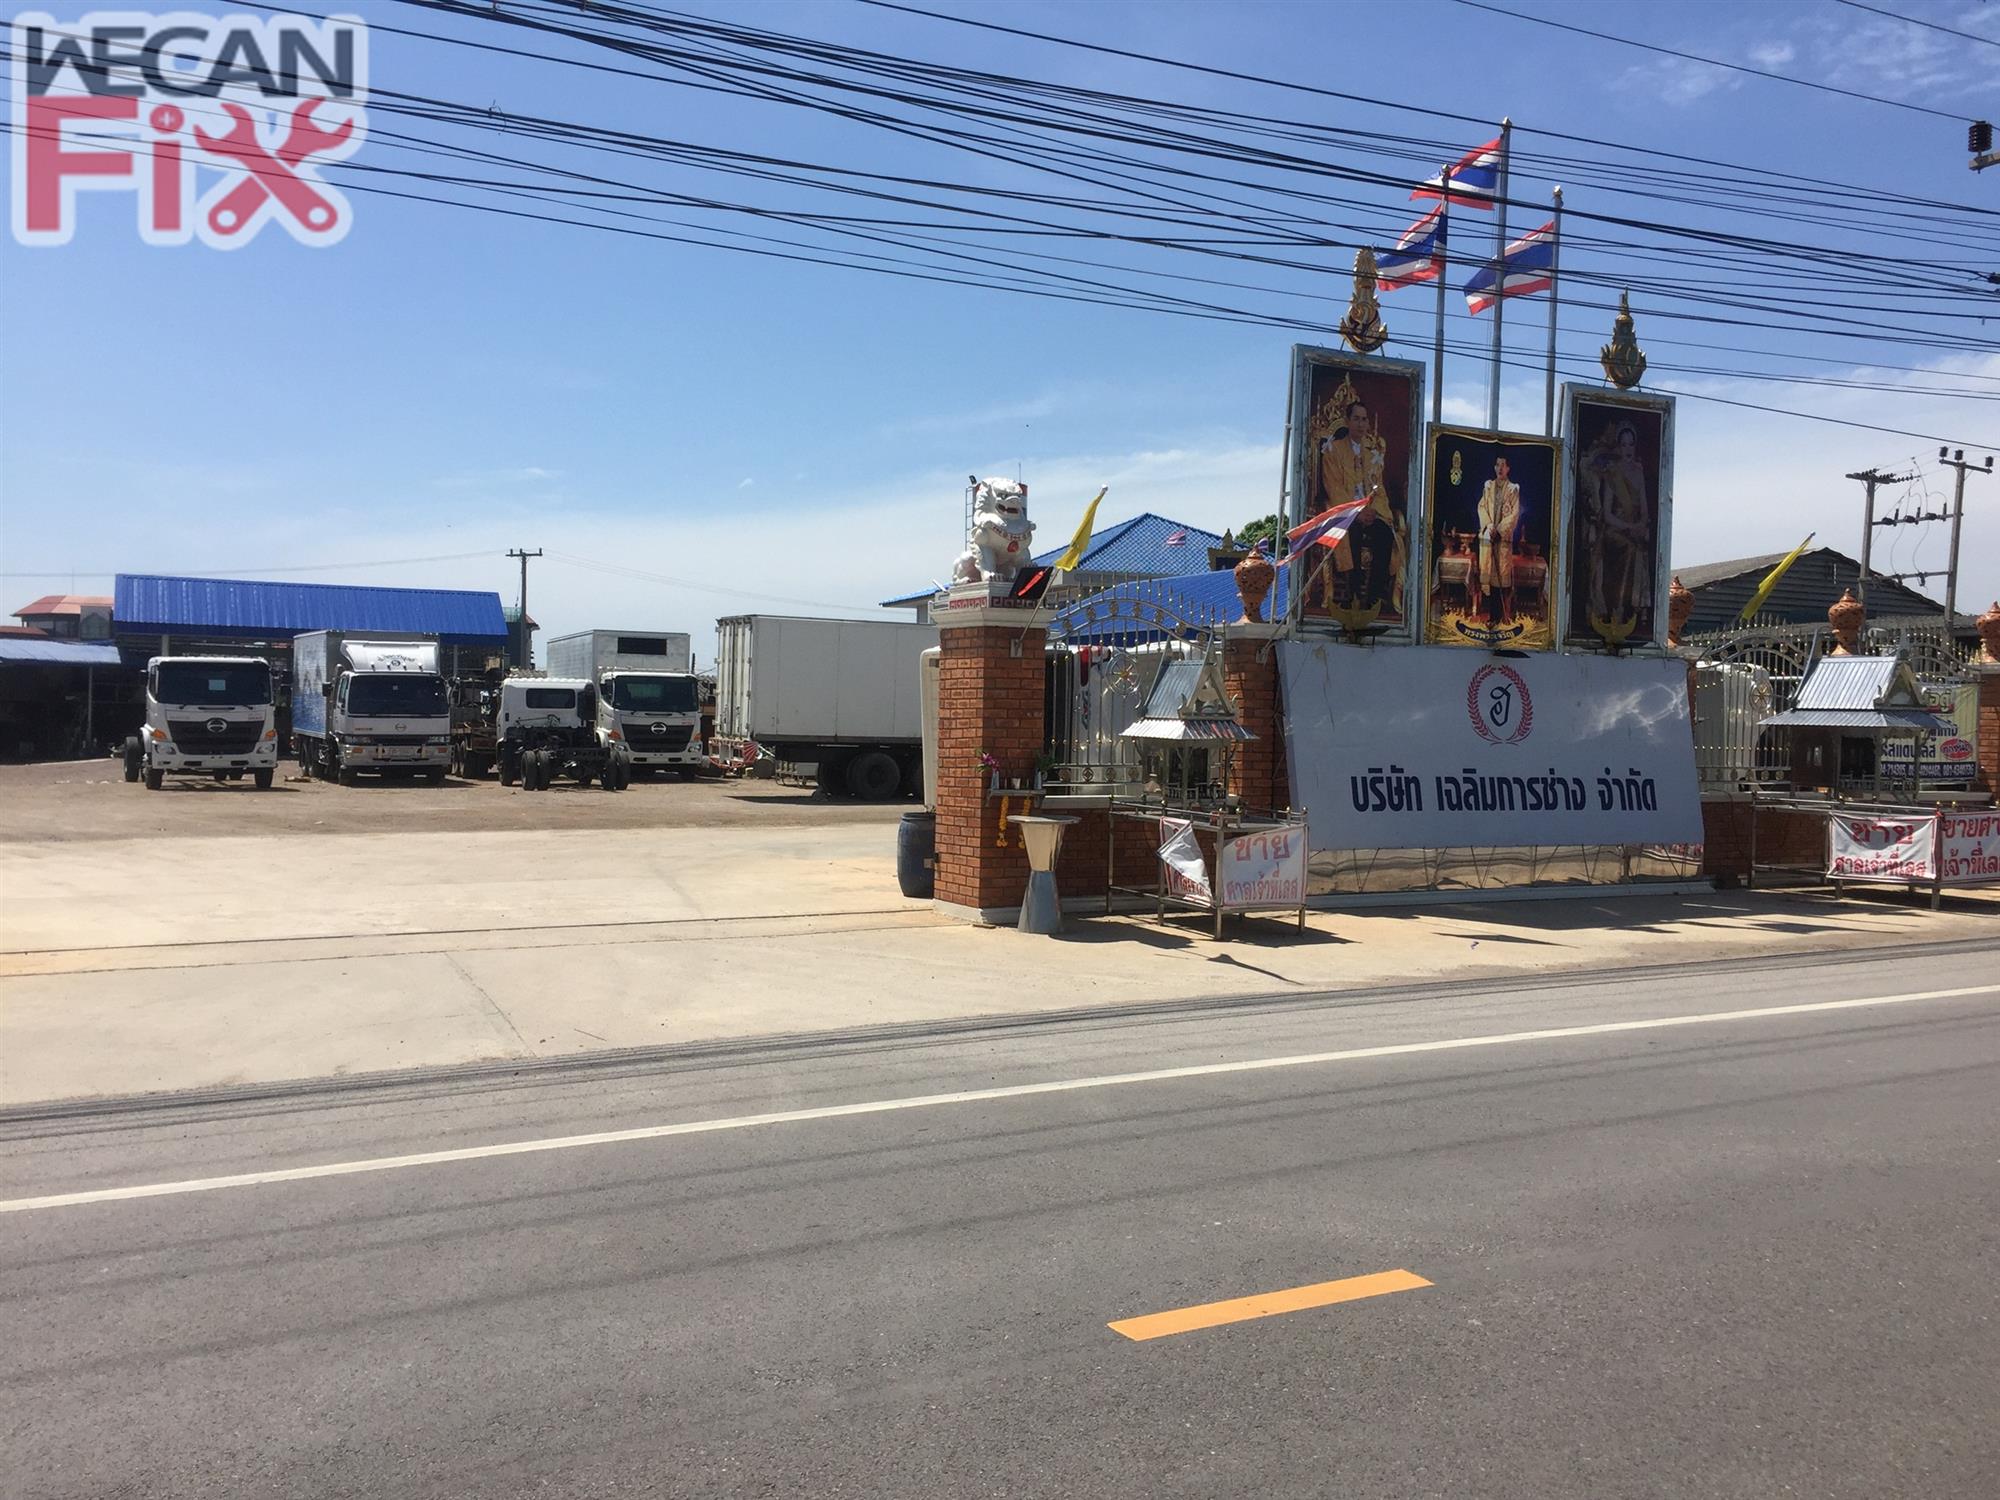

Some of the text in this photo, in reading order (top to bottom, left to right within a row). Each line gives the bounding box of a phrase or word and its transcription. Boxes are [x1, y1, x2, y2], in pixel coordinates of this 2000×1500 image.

[1350, 765, 1658, 812] บริษัท เฉลิมการช่าง จำกัด
[1235, 834, 1290, 861] ขาย
[1850, 821, 1914, 845] ขาย
[1944, 841, 2000, 876] เจ้าที่เล
